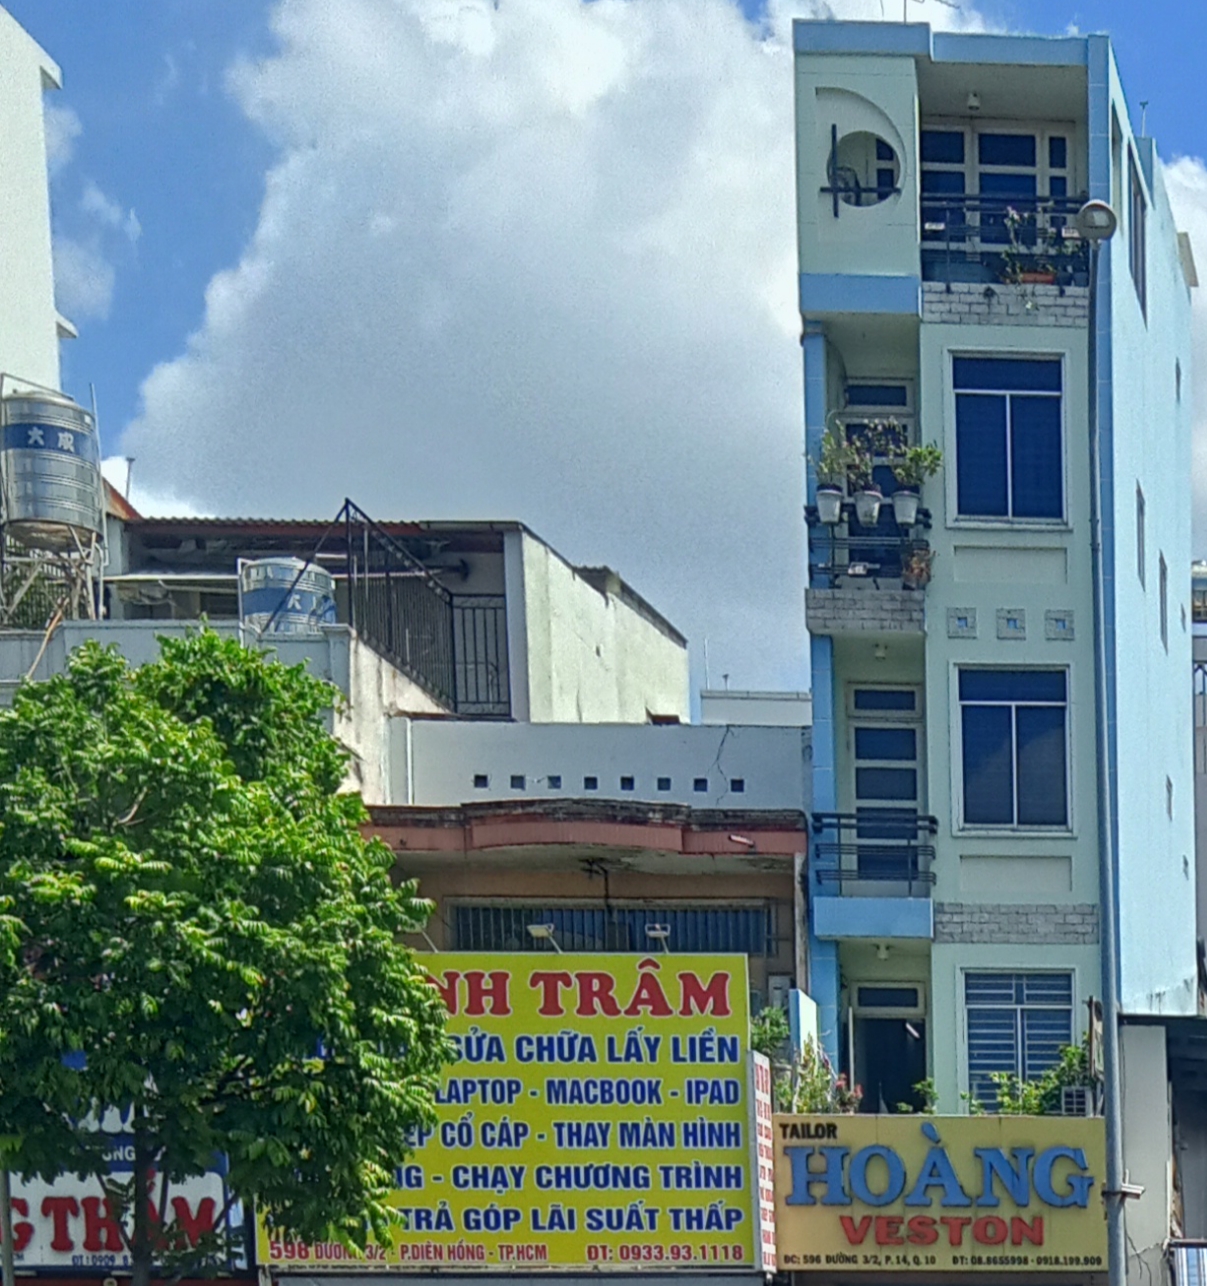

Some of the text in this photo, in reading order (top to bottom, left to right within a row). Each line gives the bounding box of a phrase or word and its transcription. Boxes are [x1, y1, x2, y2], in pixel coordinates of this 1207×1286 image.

[426, 957, 731, 1017] NH TRÂM
[516, 1030, 597, 1063] CHỮA
[607, 1026, 661, 1063] LẤY
[672, 1027, 738, 1063] LIỀN
[435, 1079, 521, 1104] LAPTOP
[546, 1079, 662, 1104] MACBOOK
[687, 1080, 740, 1104] IPAD
[441, 1111, 474, 1148] CỔ
[481, 1118, 529, 1148] CÁP
[554, 1122, 611, 1147] THAY
[619, 1118, 675, 1147] MÀN
[683, 1118, 741, 1147] HÌNH
[779, 1123, 838, 1140] TAILOR
[452, 1166, 525, 1193] CHẠY
[536, 1164, 649, 1189] CHƯƠNG
[659, 1162, 742, 1188] TRÌNH
[783, 1121, 1095, 1209] HOÀNG
[398, 1200, 743, 1232] TRẢ GÓP LÃI SUẤT THẤP
[839, 1215, 1045, 1247] VESTON
[270, 1241, 310, 1260] 598
[498, 1244, 547, 1260] TP.HCM
[587, 1245, 613, 1261] ĐT:
[619, 1244, 743, 1261] 0933.93.1118
[803, 1255, 821, 1265] 596
[826, 1252, 858, 1265] ĐƯỜNG
